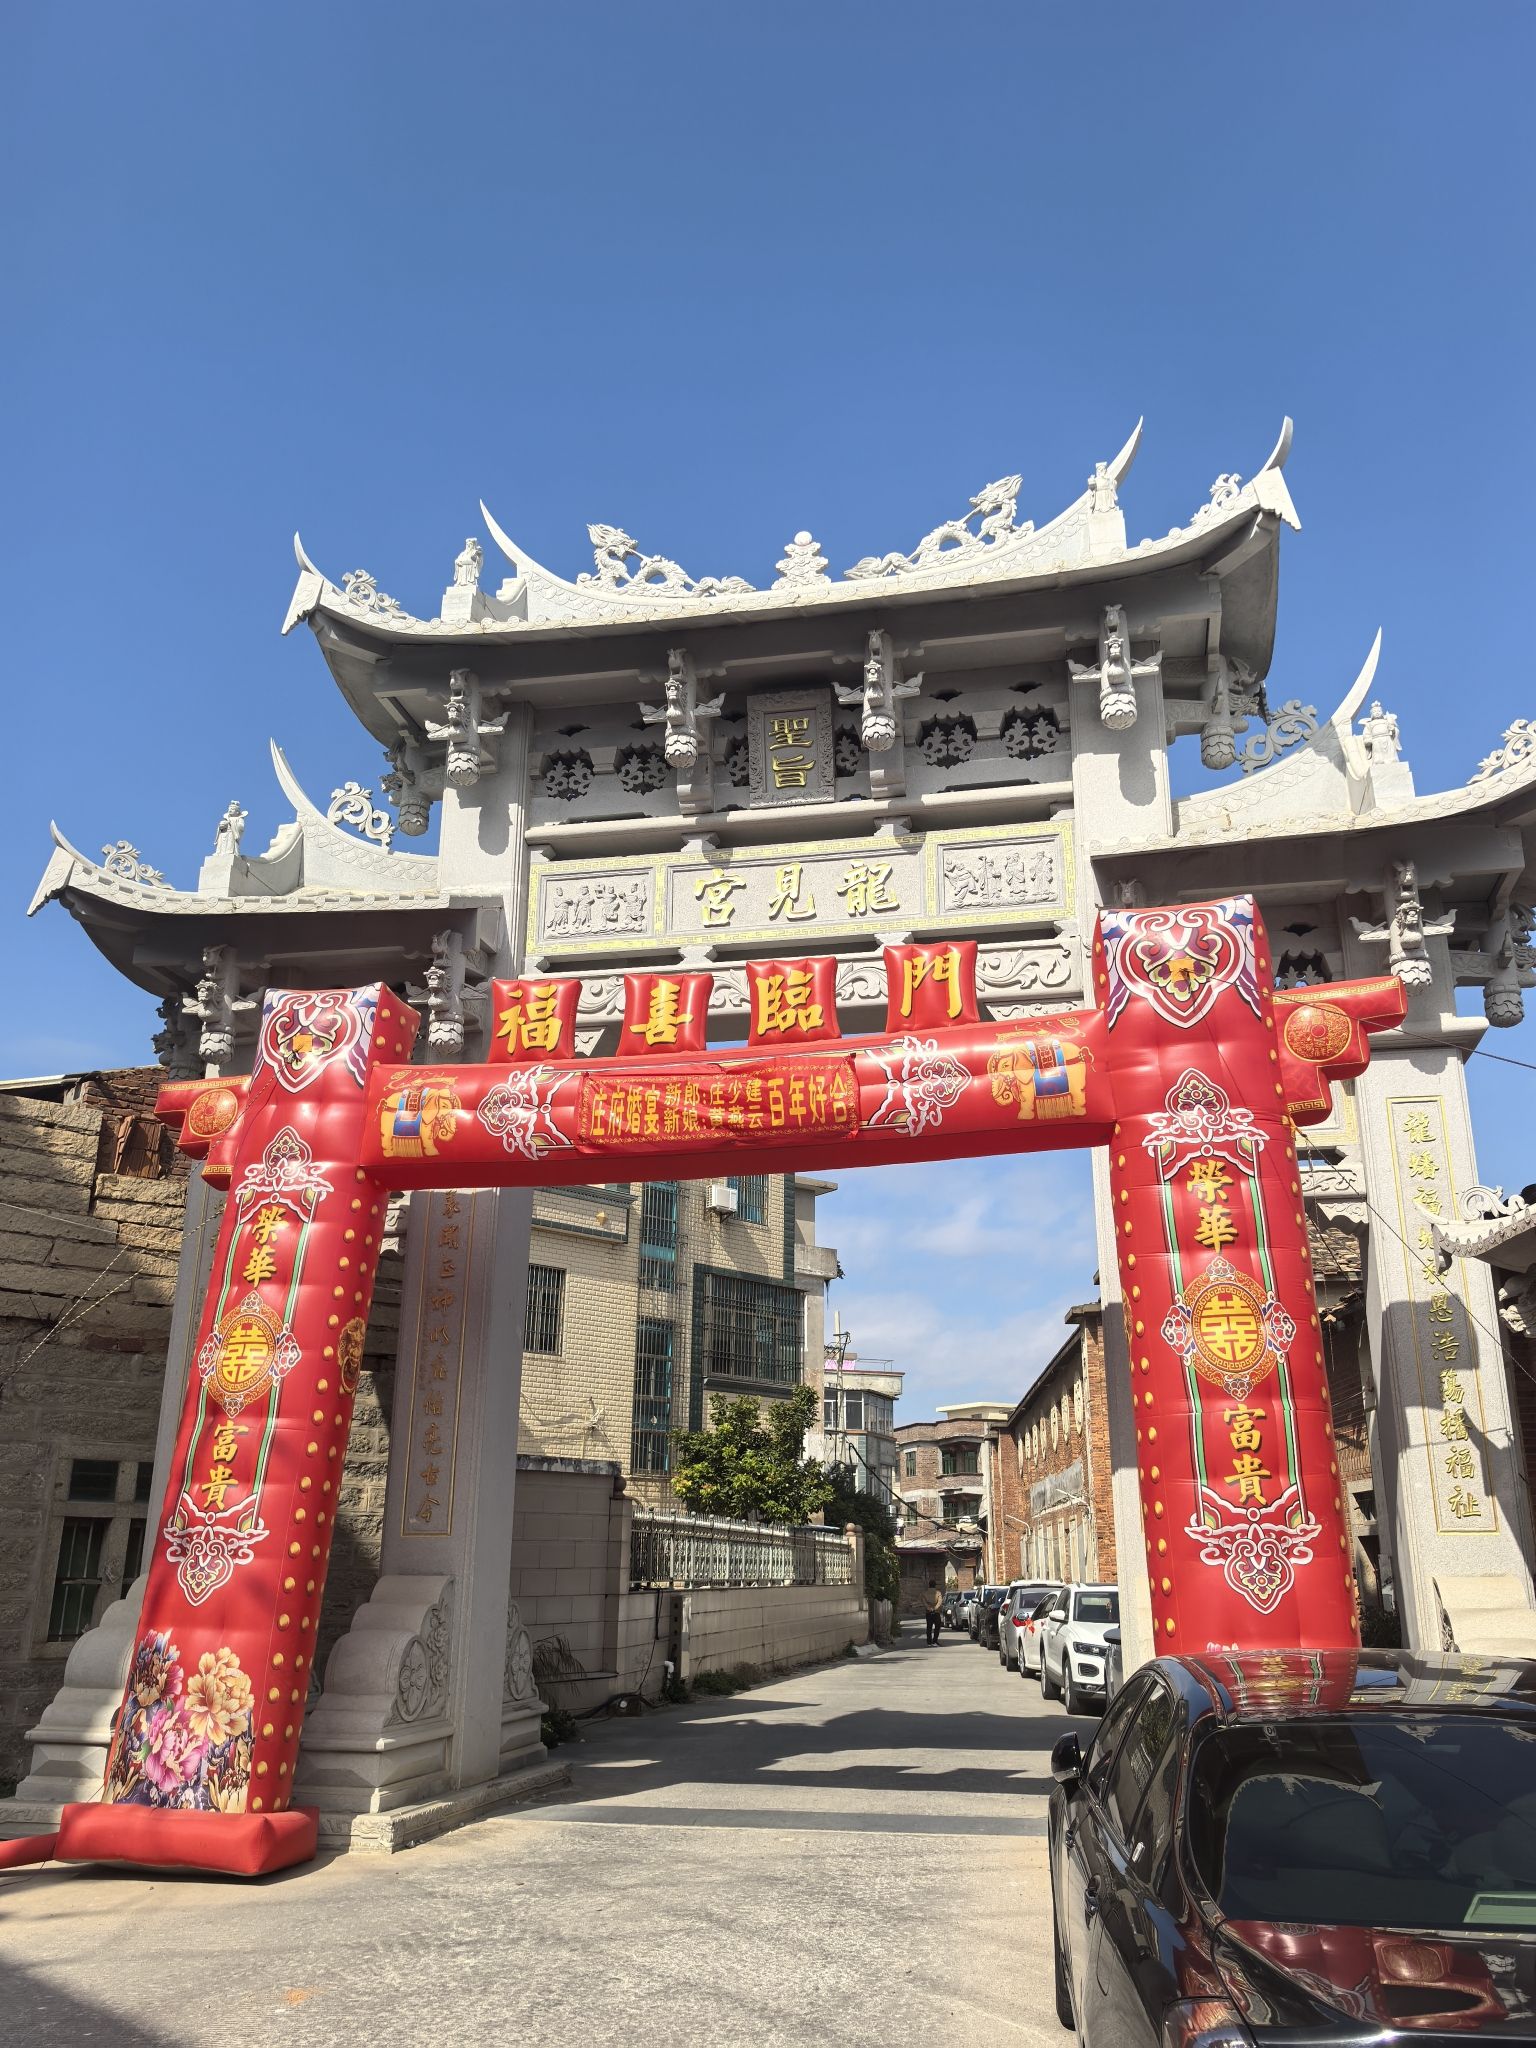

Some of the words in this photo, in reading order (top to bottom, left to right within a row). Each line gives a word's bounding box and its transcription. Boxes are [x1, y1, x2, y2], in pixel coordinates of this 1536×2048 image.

[768, 717, 816, 788] 聖旨
[498, 949, 964, 1055] 福喜臨門
[589, 1084, 661, 1137] 庄府婚宴
[767, 1071, 848, 1128] 百年好合
[243, 1205, 288, 1288] 榮華
[1186, 1159, 1239, 1253] 榮華
[1224, 1403, 1271, 1507] 富貴
[201, 1419, 250, 1511] 富貴
